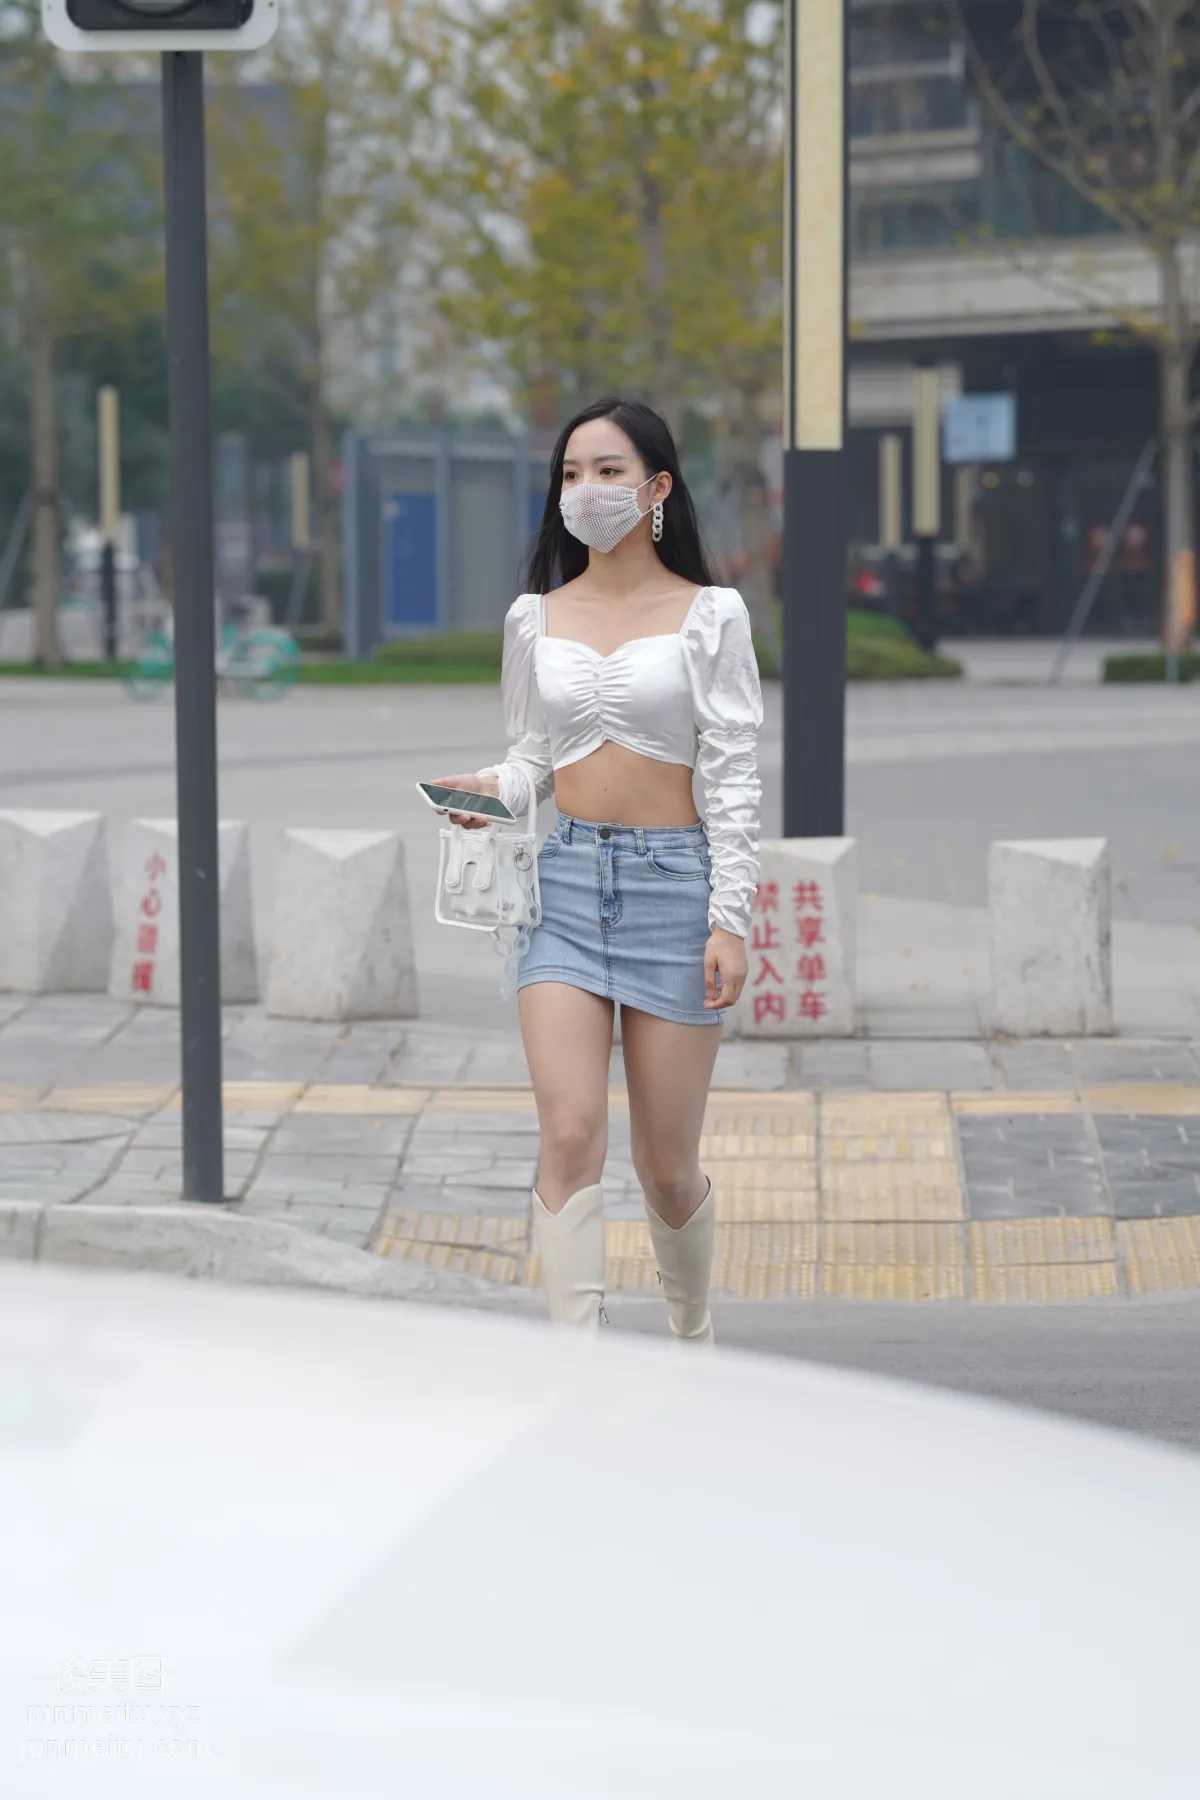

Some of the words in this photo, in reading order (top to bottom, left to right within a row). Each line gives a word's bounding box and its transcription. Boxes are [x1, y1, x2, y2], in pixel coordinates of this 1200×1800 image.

[131, 852, 166, 992] 小心
[751, 880, 787, 1025] 禁止入内
[792, 879, 828, 1021] 共享单车
